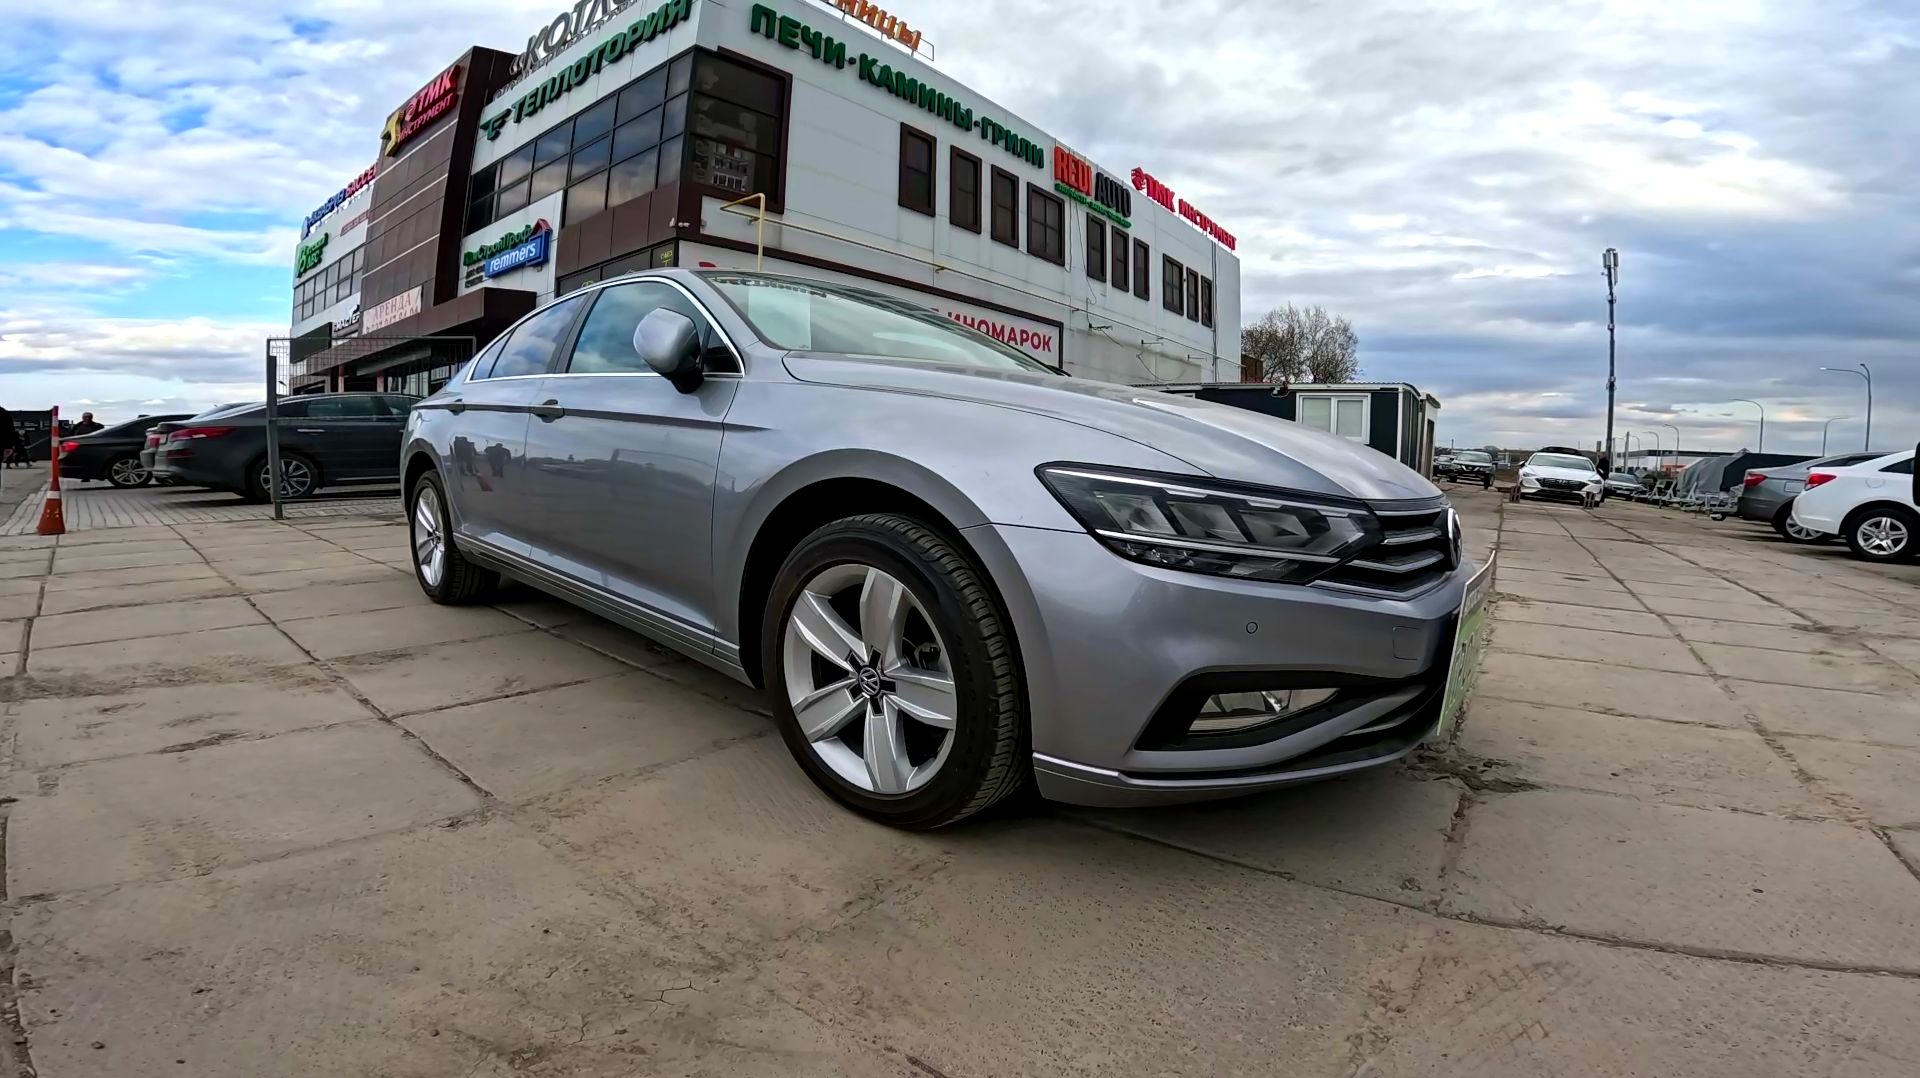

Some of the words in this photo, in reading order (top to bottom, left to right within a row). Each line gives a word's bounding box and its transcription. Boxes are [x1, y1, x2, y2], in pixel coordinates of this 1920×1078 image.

[511, 0, 694, 123] ТЕПЛОТОРИЯ
[751, 3, 846, 69] ПЕЧИ
[858, 53, 973, 132] КАМИНЫ
[980, 115, 1045, 169] ГРИЛИ
[416, 65, 461, 112] ТМК
[397, 92, 459, 143] ИНСТРУМЕНТ
[1054, 146, 1093, 197] REDI
[1094, 172, 1132, 218] AUTO
[1178, 198, 1237, 251] ИНСТРУМЕНТ
[489, 242, 536, 273] remmers
[374, 292, 412, 322] АРЕНДА
